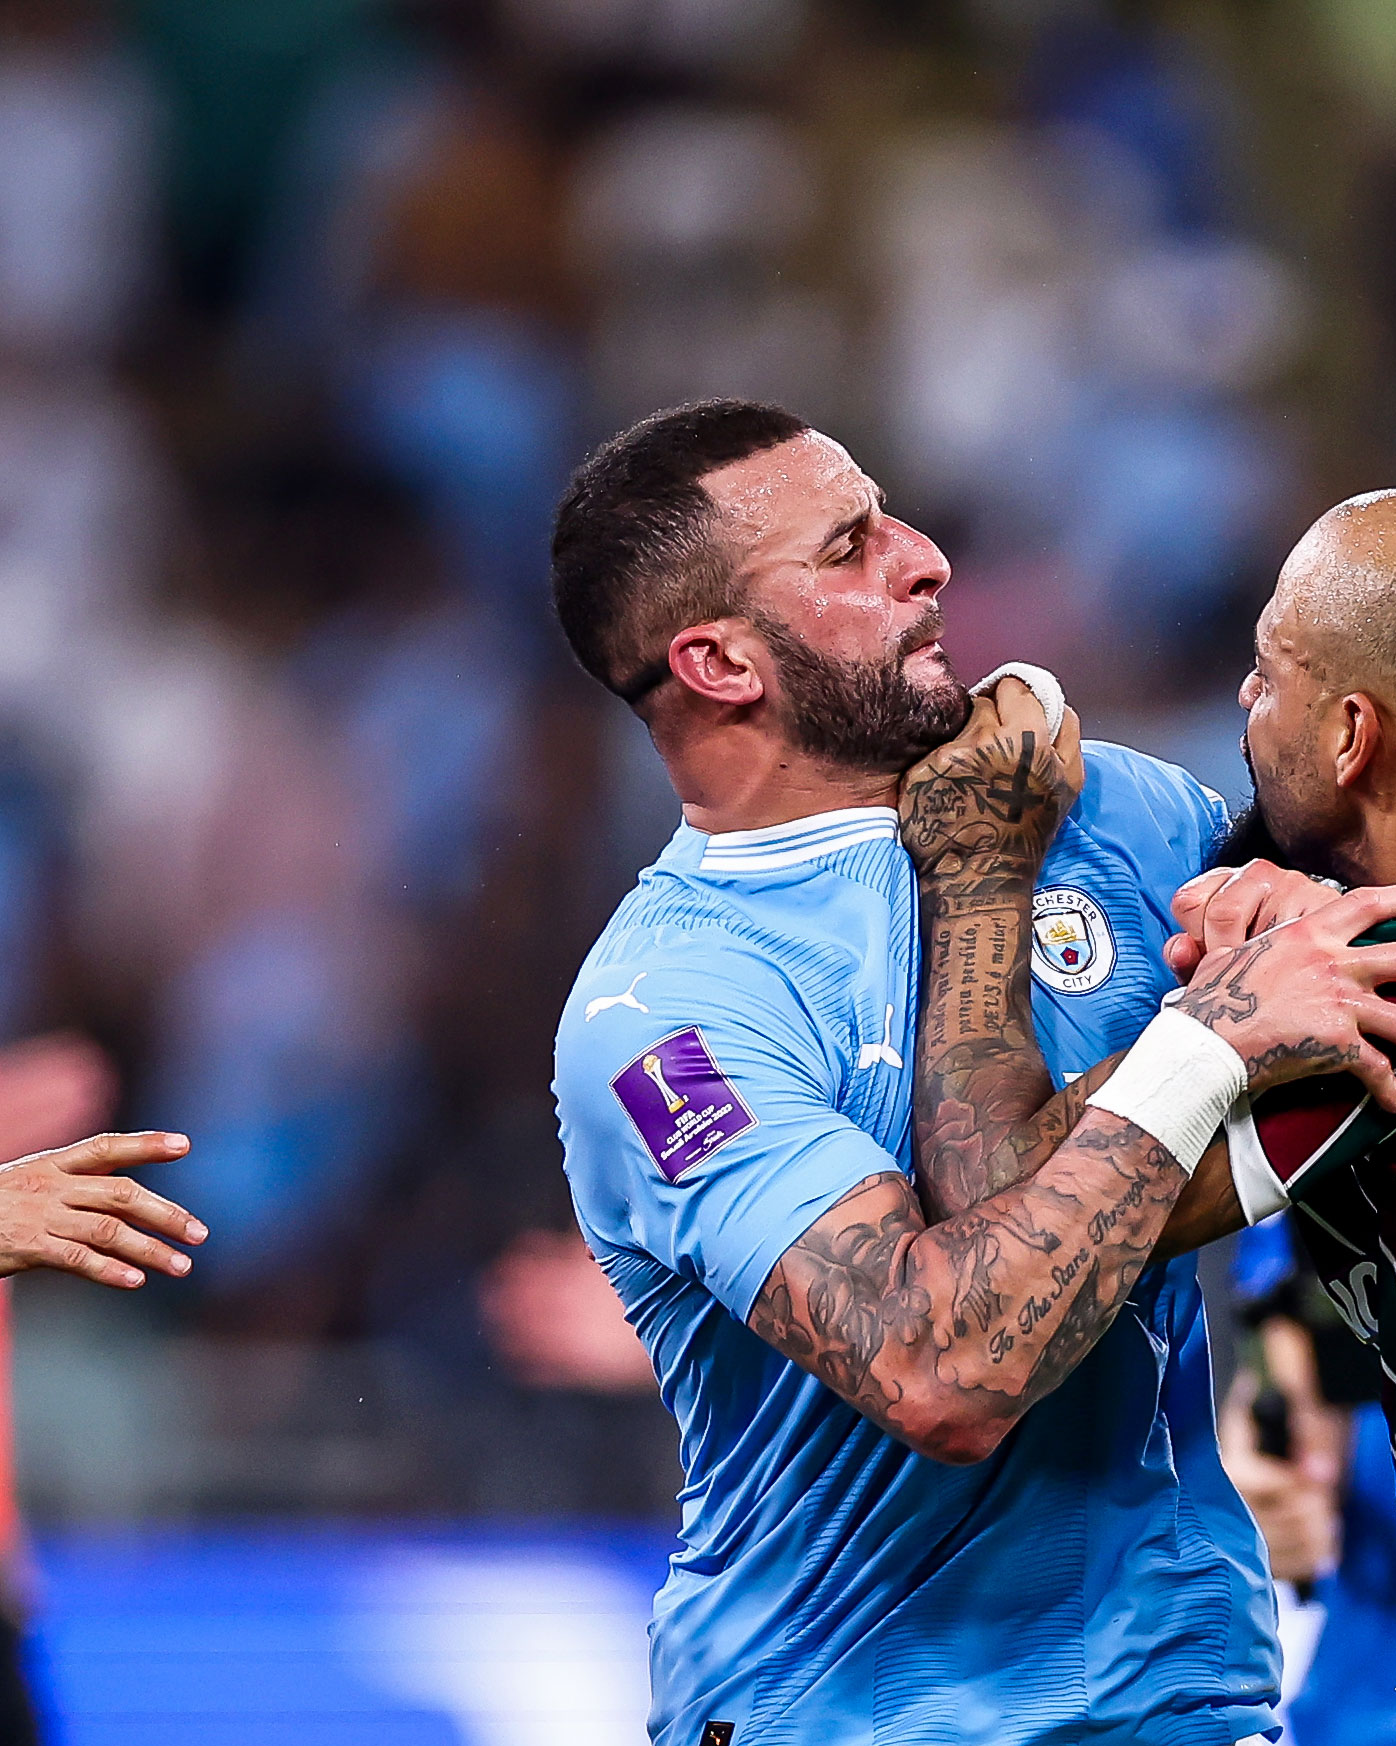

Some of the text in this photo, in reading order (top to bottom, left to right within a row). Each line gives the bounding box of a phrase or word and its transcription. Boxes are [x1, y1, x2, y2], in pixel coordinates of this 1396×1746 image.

[1036, 894, 1097, 922] CHESTER
[1062, 975, 1092, 988] CITY
[674, 1109, 696, 1128] FIFA
[680, 1115, 703, 1133] WORLD
[701, 1104, 715, 1118] CUP
